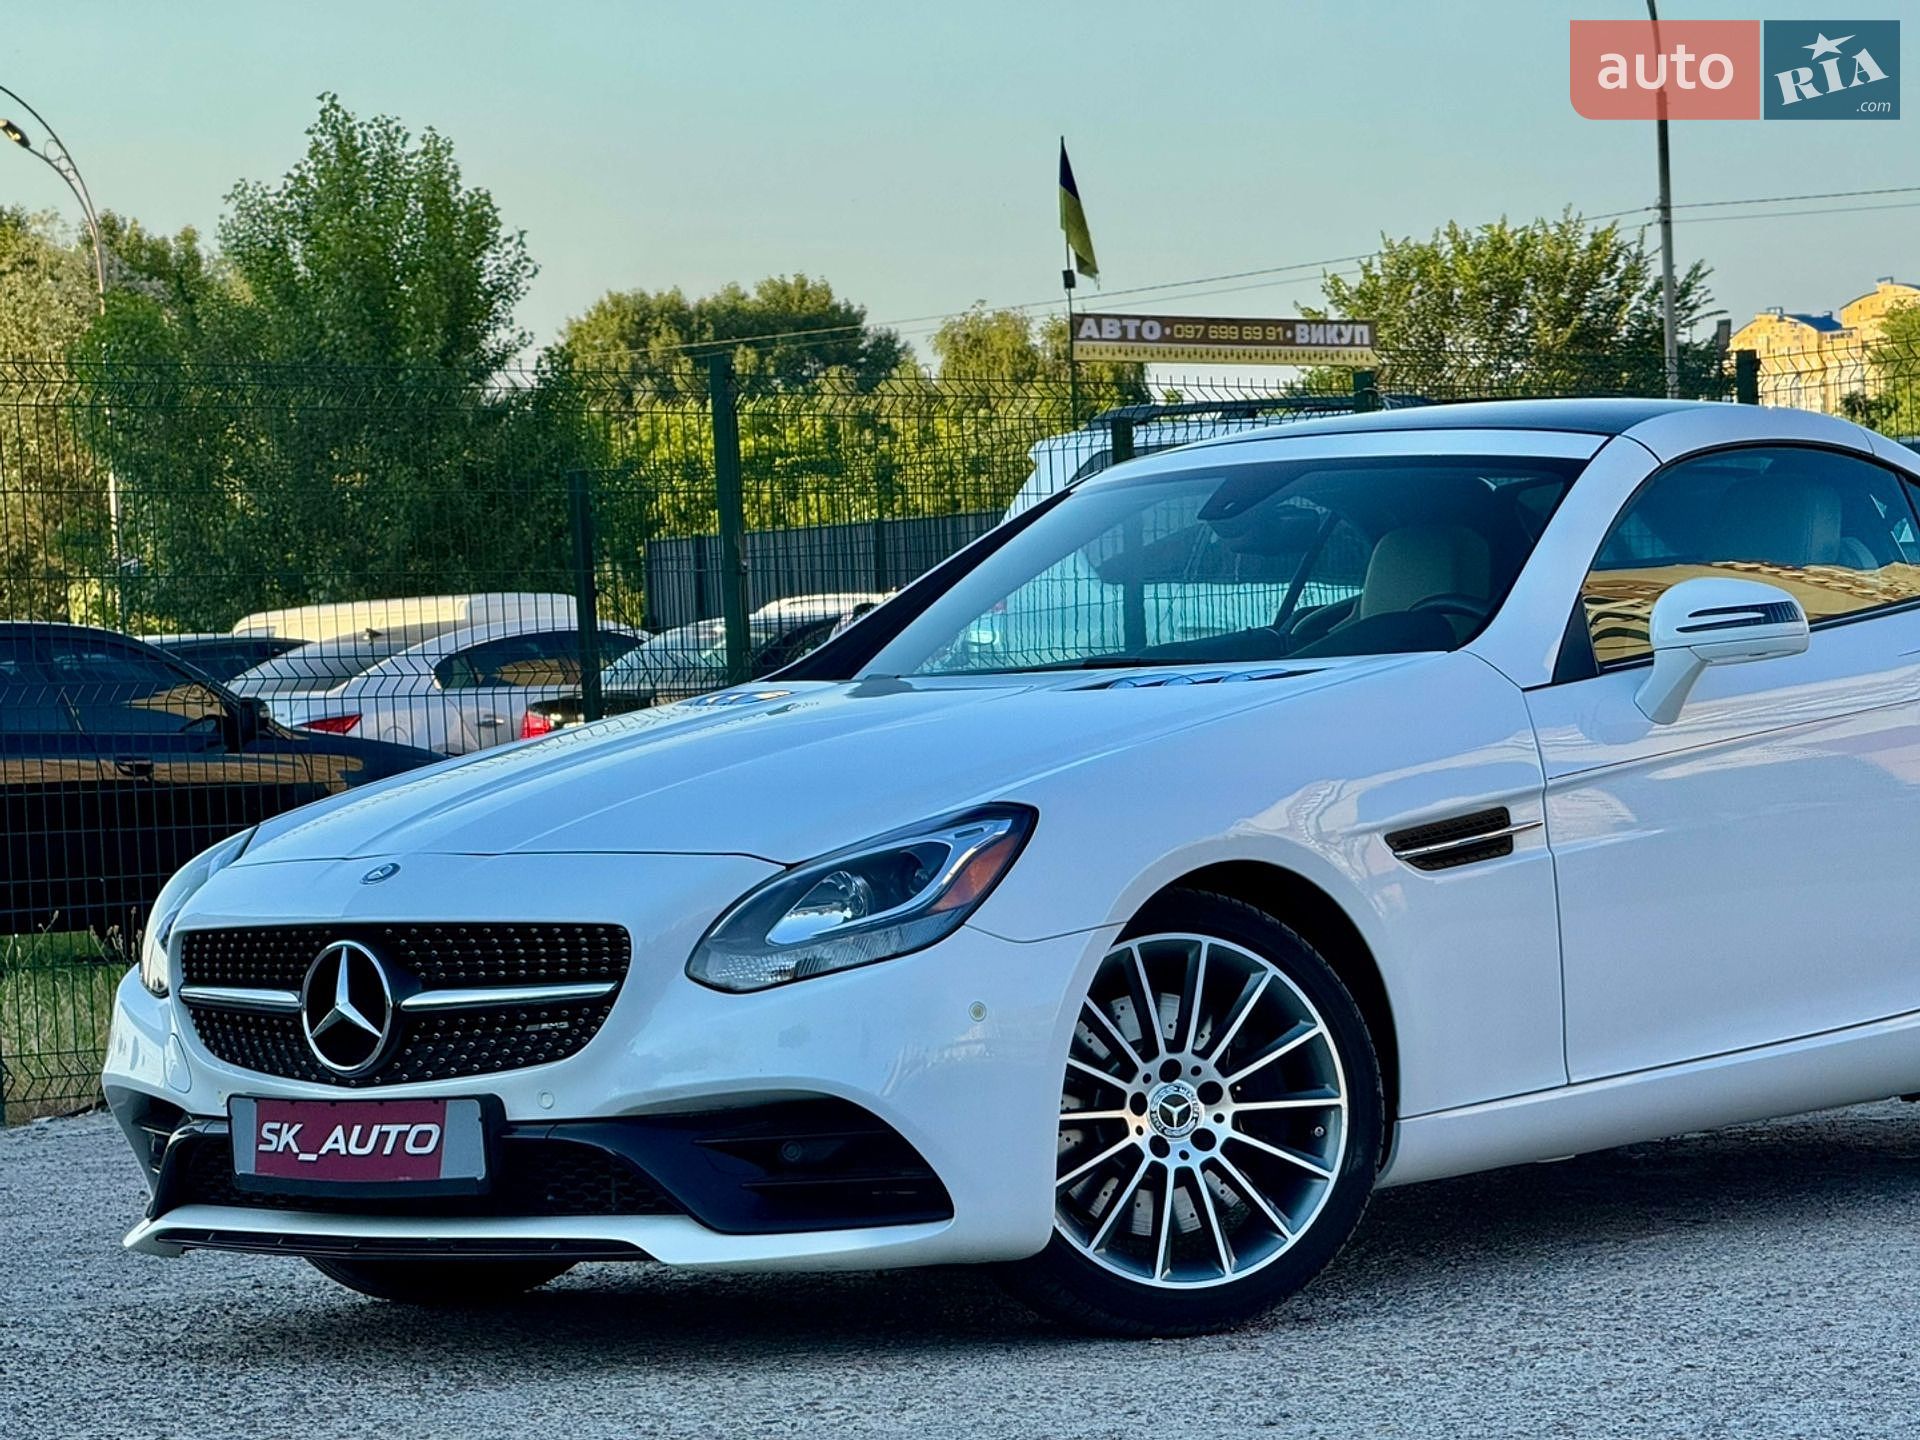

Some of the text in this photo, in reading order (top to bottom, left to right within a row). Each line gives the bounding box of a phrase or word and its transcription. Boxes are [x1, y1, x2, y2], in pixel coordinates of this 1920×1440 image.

[1078, 318, 1370, 345] АВТО 097 699 69 91 ВИКУП
[258, 1122, 441, 1162] SK_AUTO
